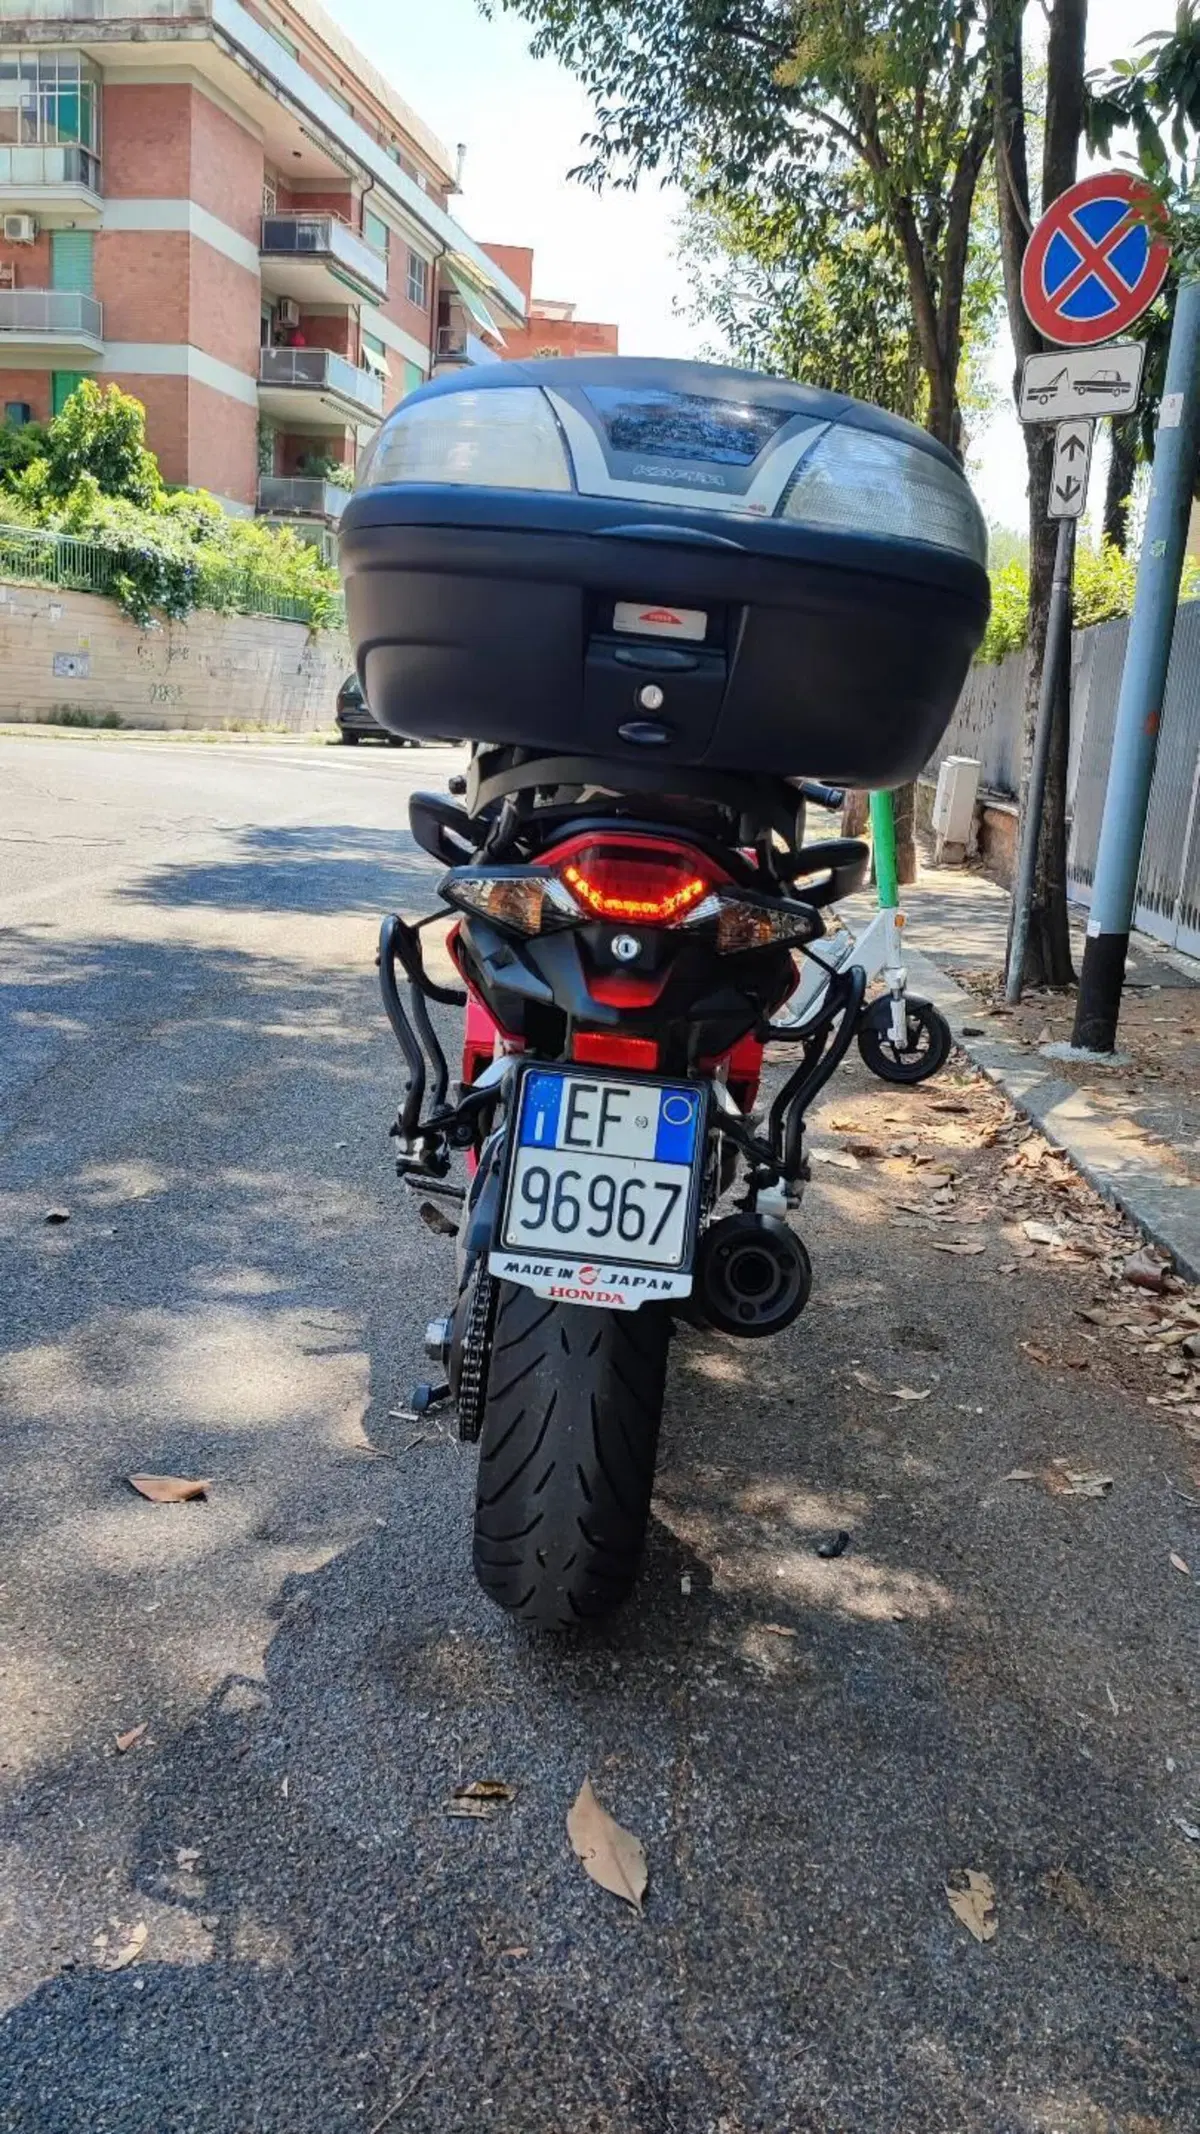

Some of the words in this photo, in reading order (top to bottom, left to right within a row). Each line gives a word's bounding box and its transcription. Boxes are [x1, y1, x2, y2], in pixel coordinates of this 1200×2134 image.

[564, 1082, 631, 1148] EF
[520, 1166, 682, 1245] 96967
[503, 1262, 555, 1277] MADE
[557, 1267, 574, 1280] IN
[602, 1273, 674, 1291] JAPAN
[548, 1286, 626, 1305] HONDA
